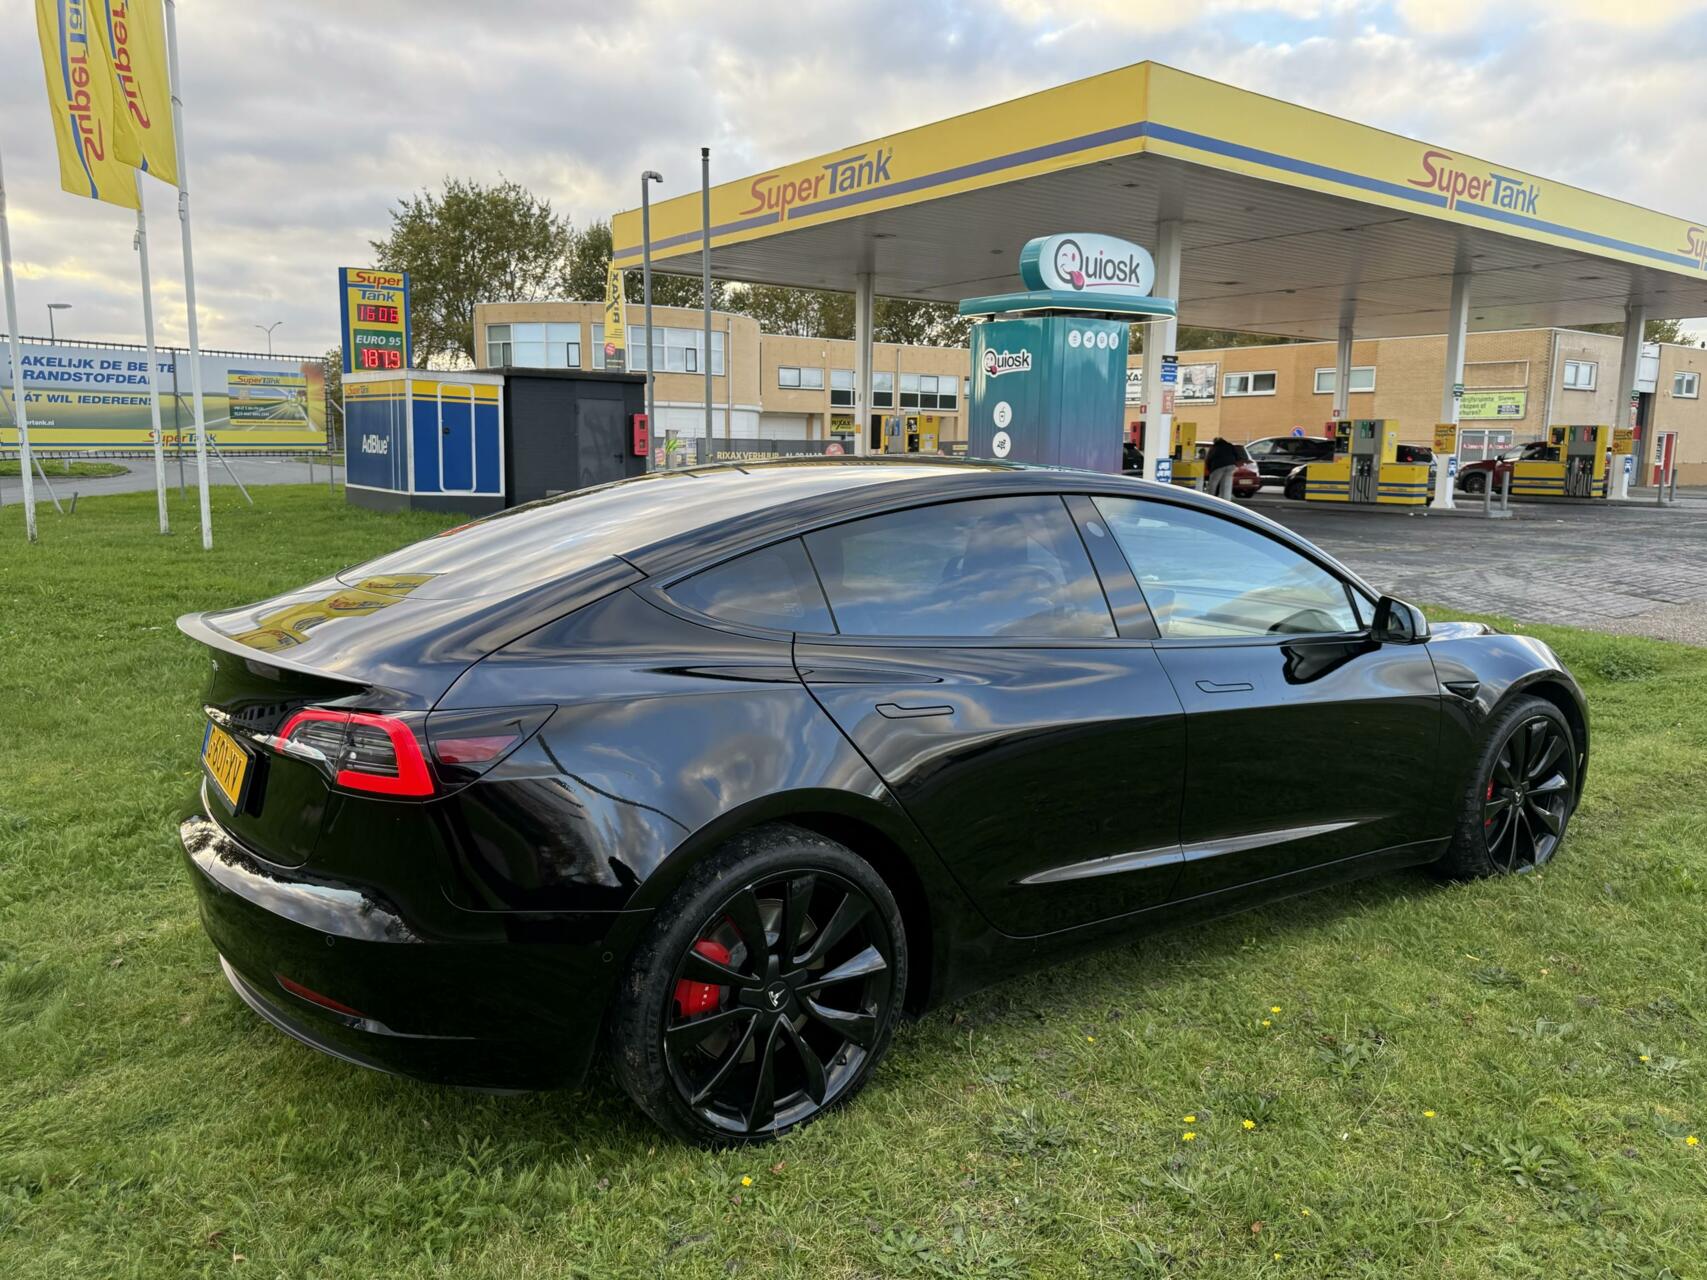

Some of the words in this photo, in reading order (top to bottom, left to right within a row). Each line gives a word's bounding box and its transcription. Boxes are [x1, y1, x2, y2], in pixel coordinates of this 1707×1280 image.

[739, 148, 892, 222] SuperTank
[1407, 150, 1538, 215] SuperTank
[1054, 239, 1140, 291] Quiosk
[349, 271, 402, 289] Super
[358, 289, 395, 302] Tank
[356, 335, 386, 345] EURO
[389, 338, 402, 346] 95
[9, 355, 94, 369] AKELIJK
[100, 360, 122, 371] DE
[127, 361, 175, 373] BETE
[985, 350, 1030, 375] Quiosk
[10, 369, 150, 385] RANDSTOFDEA
[47, 394, 72, 403] WIL
[717, 451, 741, 460] RIXAX
